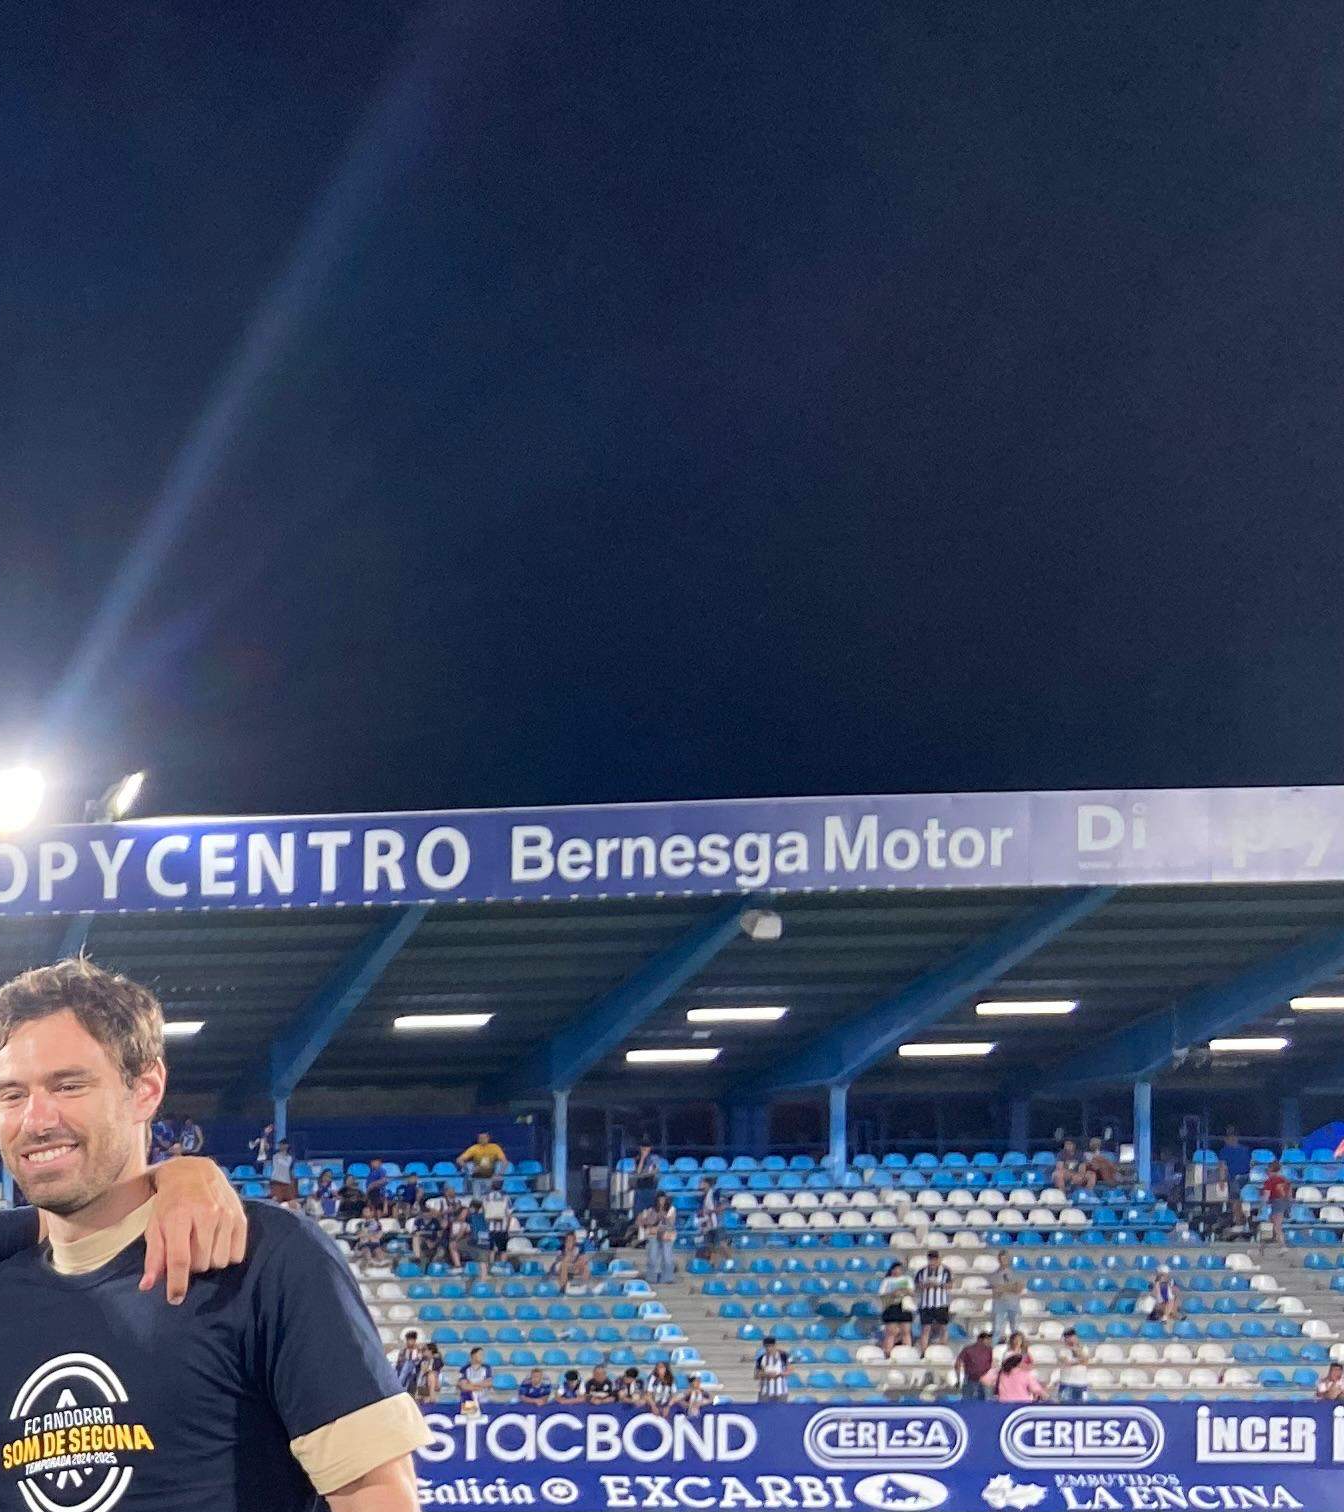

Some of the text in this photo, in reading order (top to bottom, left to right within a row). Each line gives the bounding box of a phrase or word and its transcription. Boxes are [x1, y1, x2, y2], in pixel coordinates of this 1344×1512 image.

[512, 814, 1013, 888] Bernesga Motor
[24, 1406, 114, 1437] FC ANDORRA
[2, 1435, 40, 1470] SOM
[43, 1430, 66, 1460] DE
[68, 1424, 155, 1455] SEGONA
[600, 1475, 853, 1508] EXCARBI
[1060, 1485, 1304, 1510] LA ENCINA
